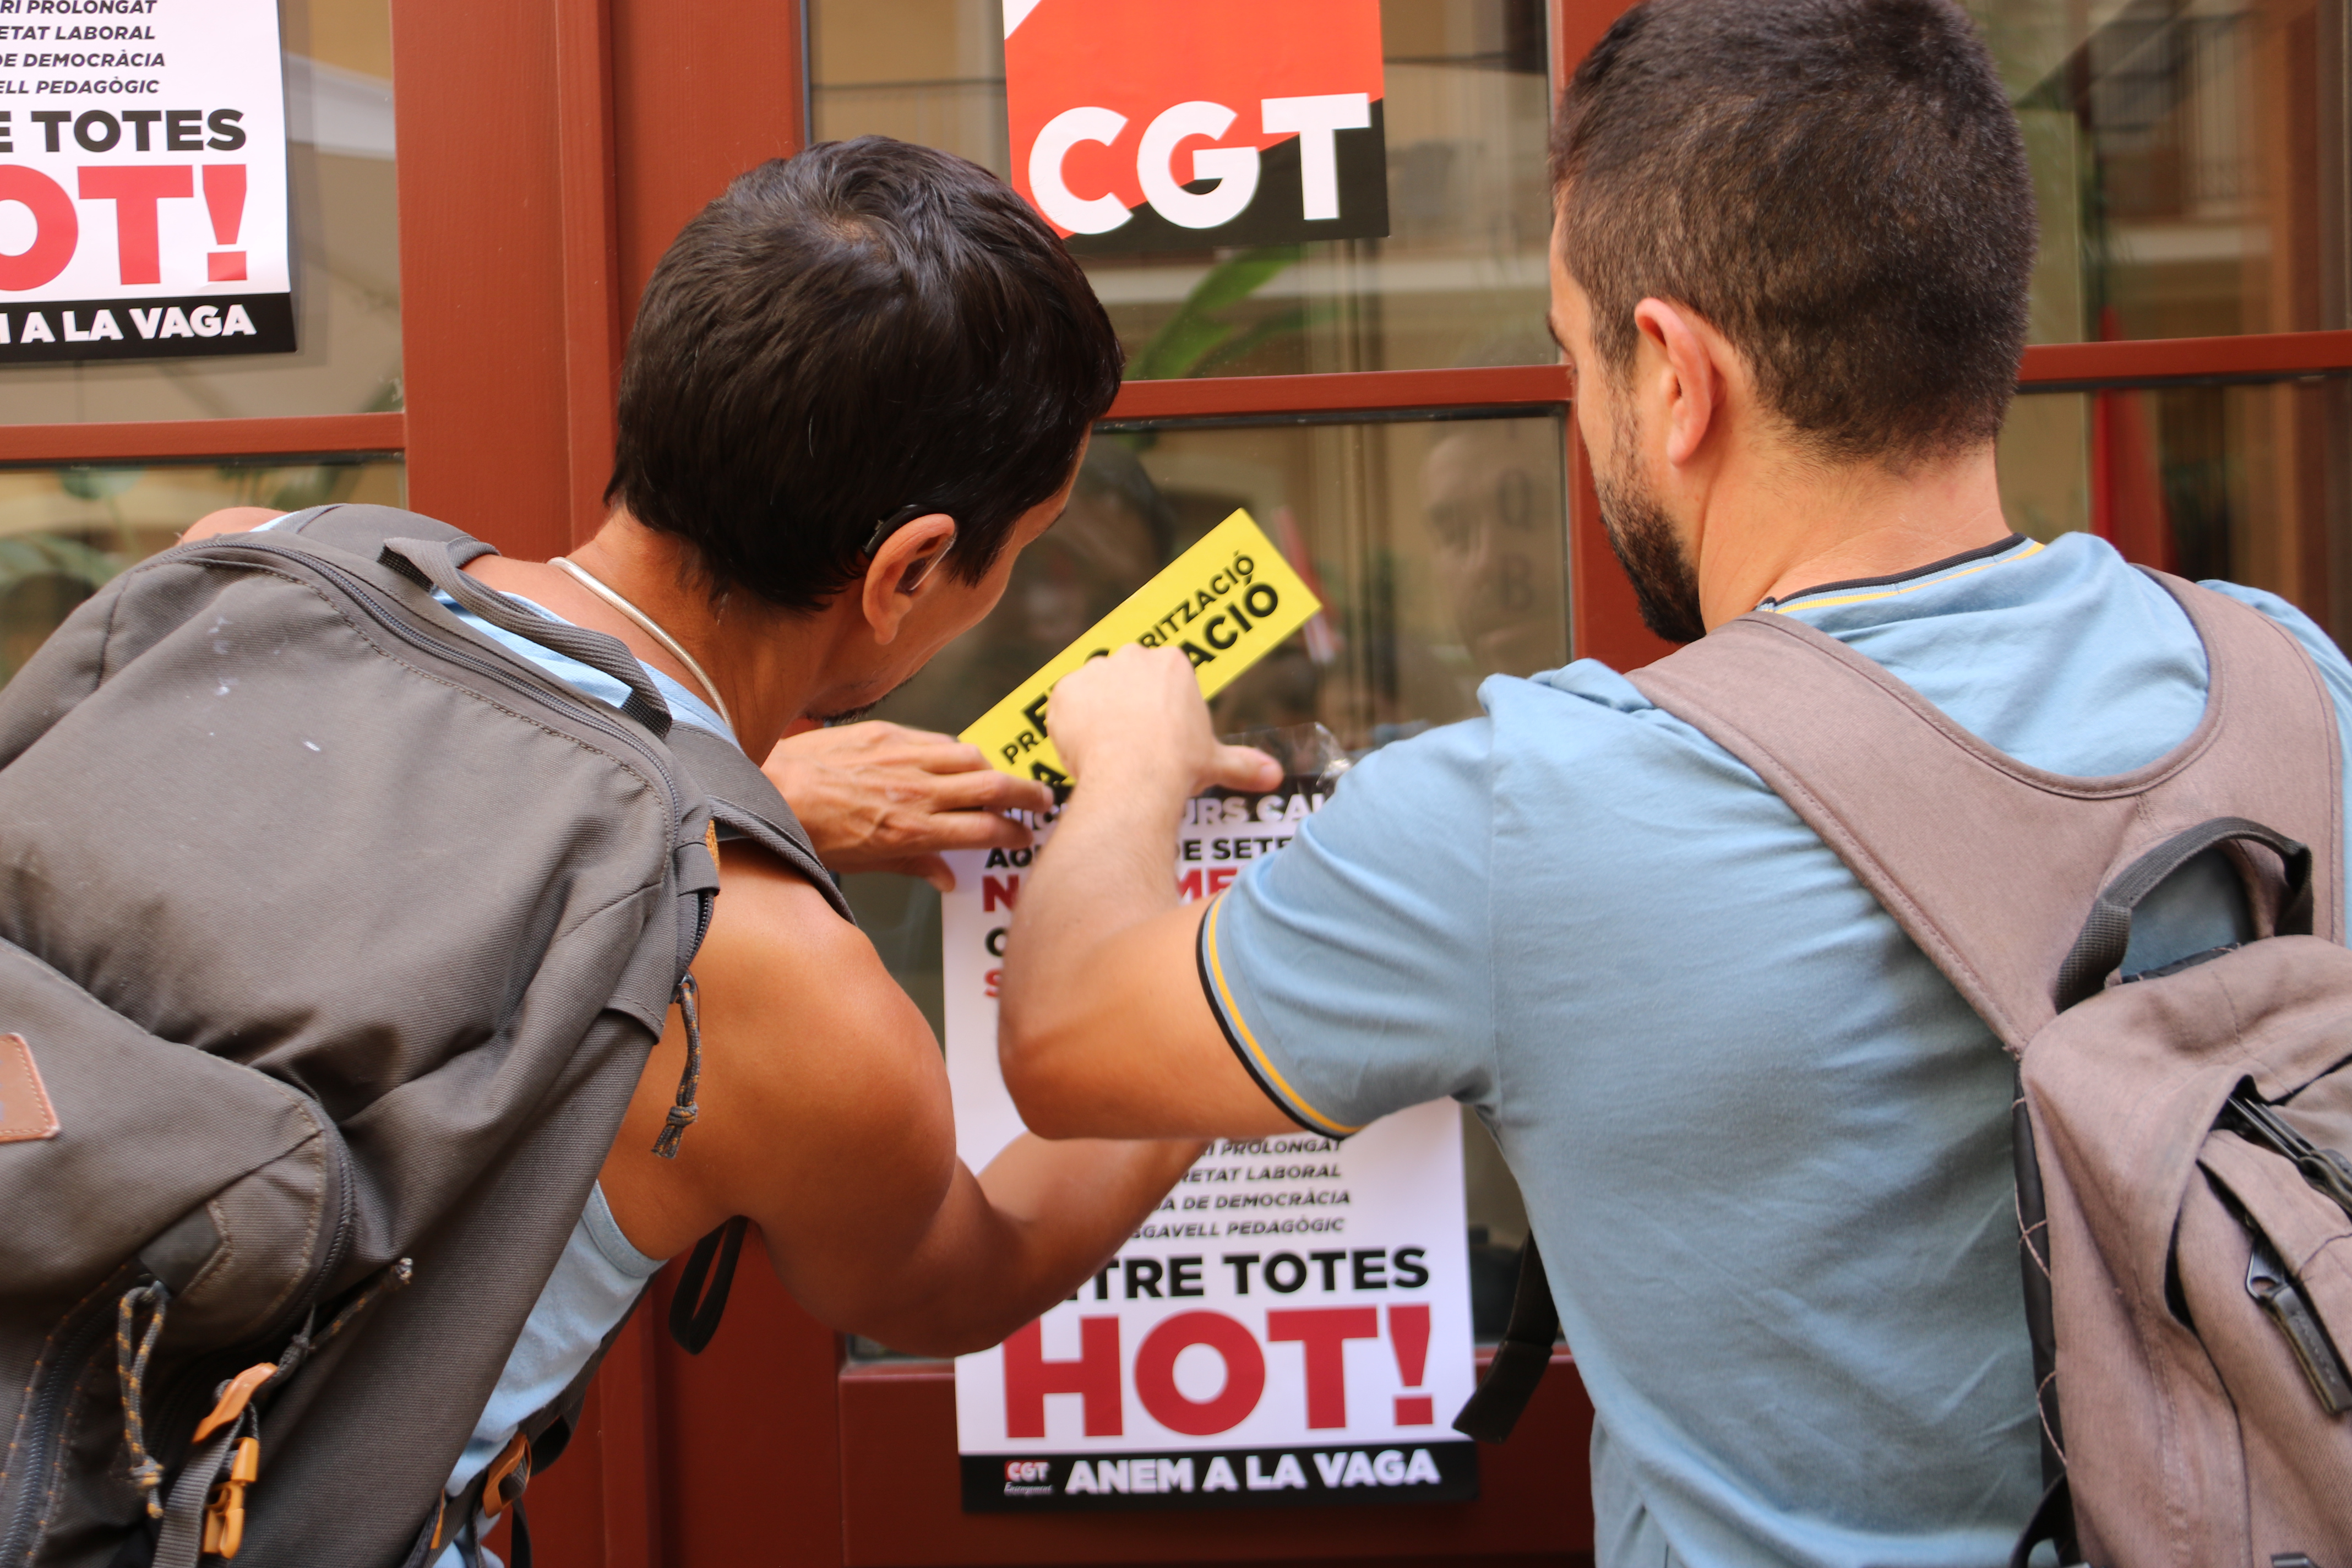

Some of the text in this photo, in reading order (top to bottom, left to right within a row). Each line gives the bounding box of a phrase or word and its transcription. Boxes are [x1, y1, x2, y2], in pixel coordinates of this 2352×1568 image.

[26, 0, 157, 14] PROLONGAT
[55, 26, 156, 40] LABORAL
[23, 49, 166, 67] DEMOCRÀCIA
[36, 76, 160, 94] PEDAGÒGIC
[31, 109, 247, 153] TOTES
[1028, 92, 1371, 235] CGT
[20, 312, 56, 344] A
[62, 310, 124, 342] LA
[128, 304, 257, 339] VAGA
[1245, 1163, 1342, 1180] LABORAL
[1181, 1195, 1209, 1210] DE
[1215, 1188, 1351, 1208] DEMOCRÀCIA
[1227, 1214, 1344, 1235] PEDAGÒGIC
[1223, 1248, 1429, 1295] TOTES
[1003, 1304, 1434, 1438] HOT!
[1007, 1461, 1050, 1482] CGT
[1065, 1449, 1441, 1493] ANEM A LA VAGA
